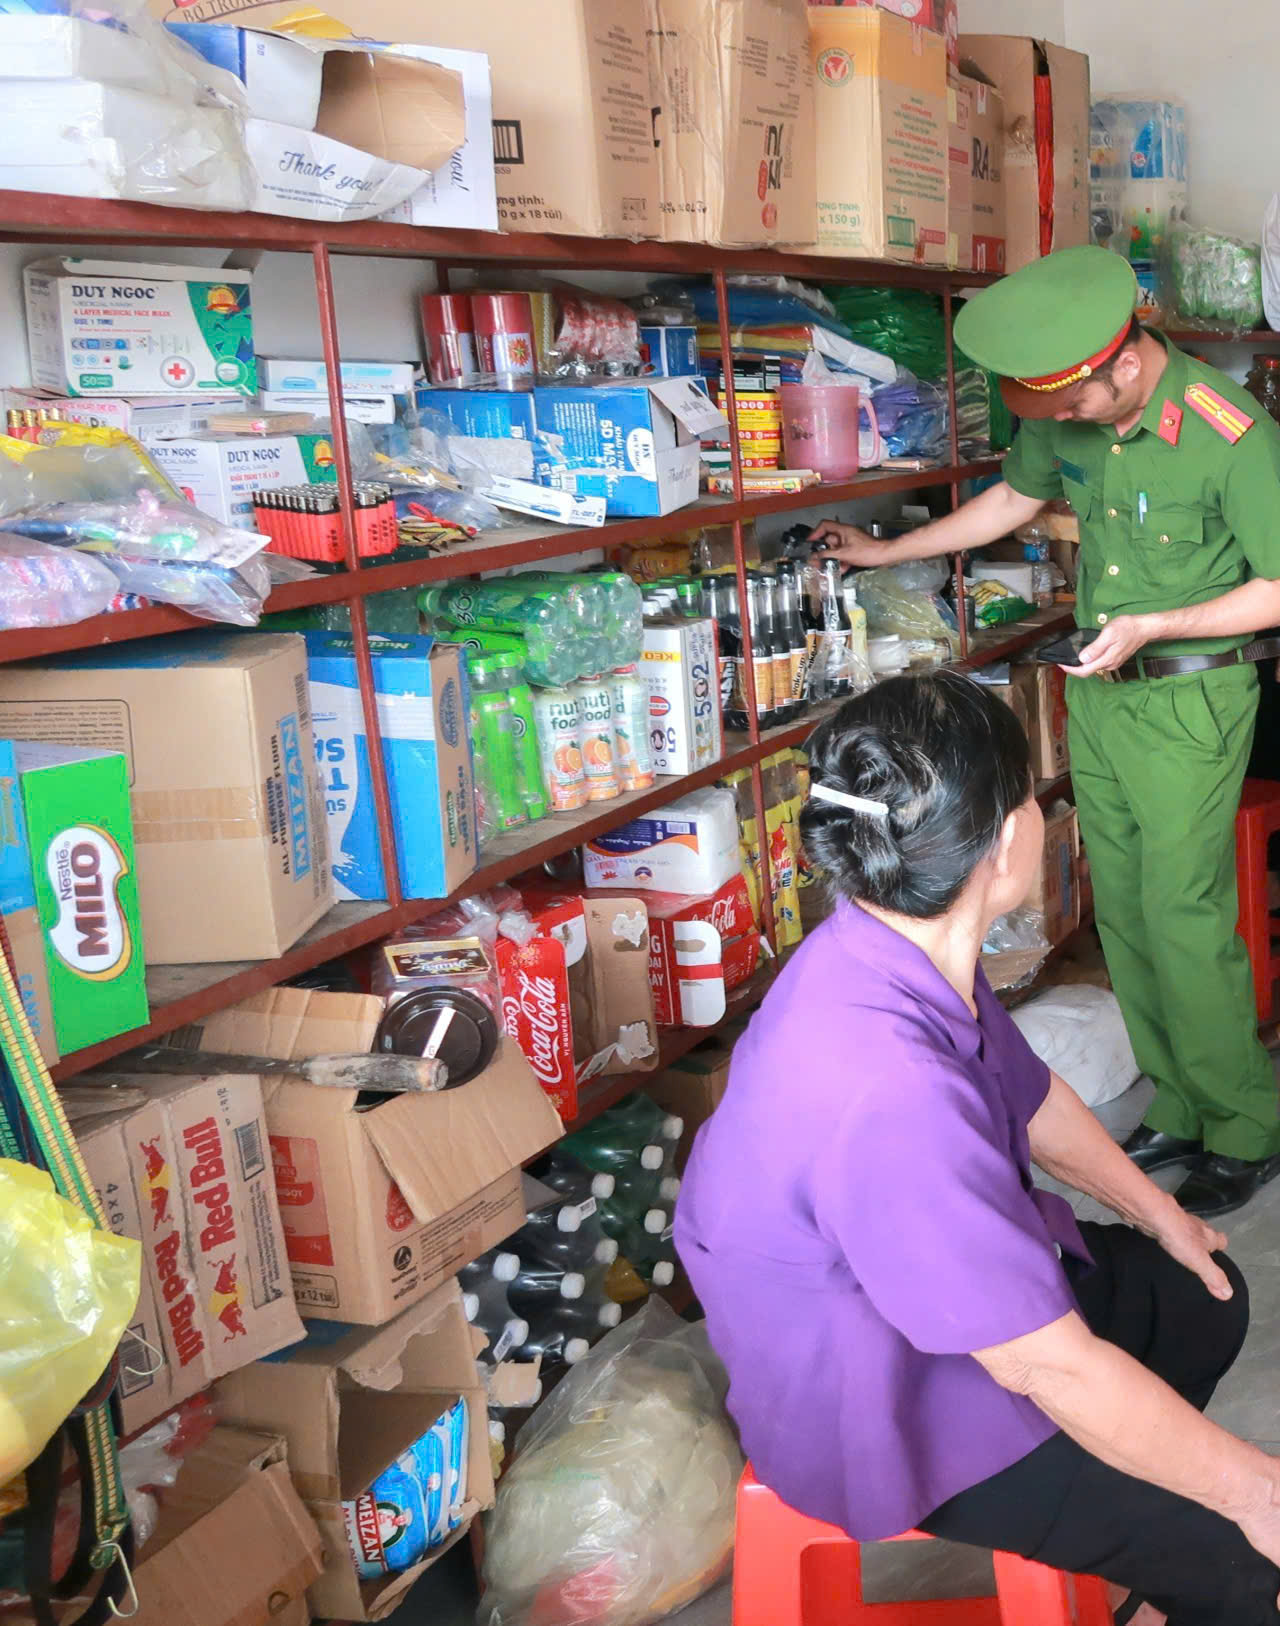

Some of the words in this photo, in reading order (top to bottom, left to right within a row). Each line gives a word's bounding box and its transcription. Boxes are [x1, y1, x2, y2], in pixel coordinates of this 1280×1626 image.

[278, 151, 337, 181] Thank
[335, 176, 385, 194] you!
[528, 210, 543, 218] 18
[72, 286, 106, 298] DUY
[600, 419, 614, 439] 5D
[227, 450, 250, 464] DUY
[253, 448, 280, 463] NGỌC
[549, 701, 580, 717] nut
[551, 717, 579, 730] foo
[270, 734, 282, 778] FLOUR
[266, 776, 279, 845] PREMIUM
[282, 721, 308, 868] MEIZAN
[70, 841, 111, 957] MILO
[518, 968, 563, 1084] Coca-Cola
[183, 1116, 226, 1188] Bull
[106, 1183, 119, 1194] 4
[111, 1212, 125, 1225] 6
[193, 1182, 237, 1252] Red
[154, 1230, 189, 1303] Red
[167, 1293, 206, 1368] Bull
[358, 1494, 382, 1561] MEIZAN
